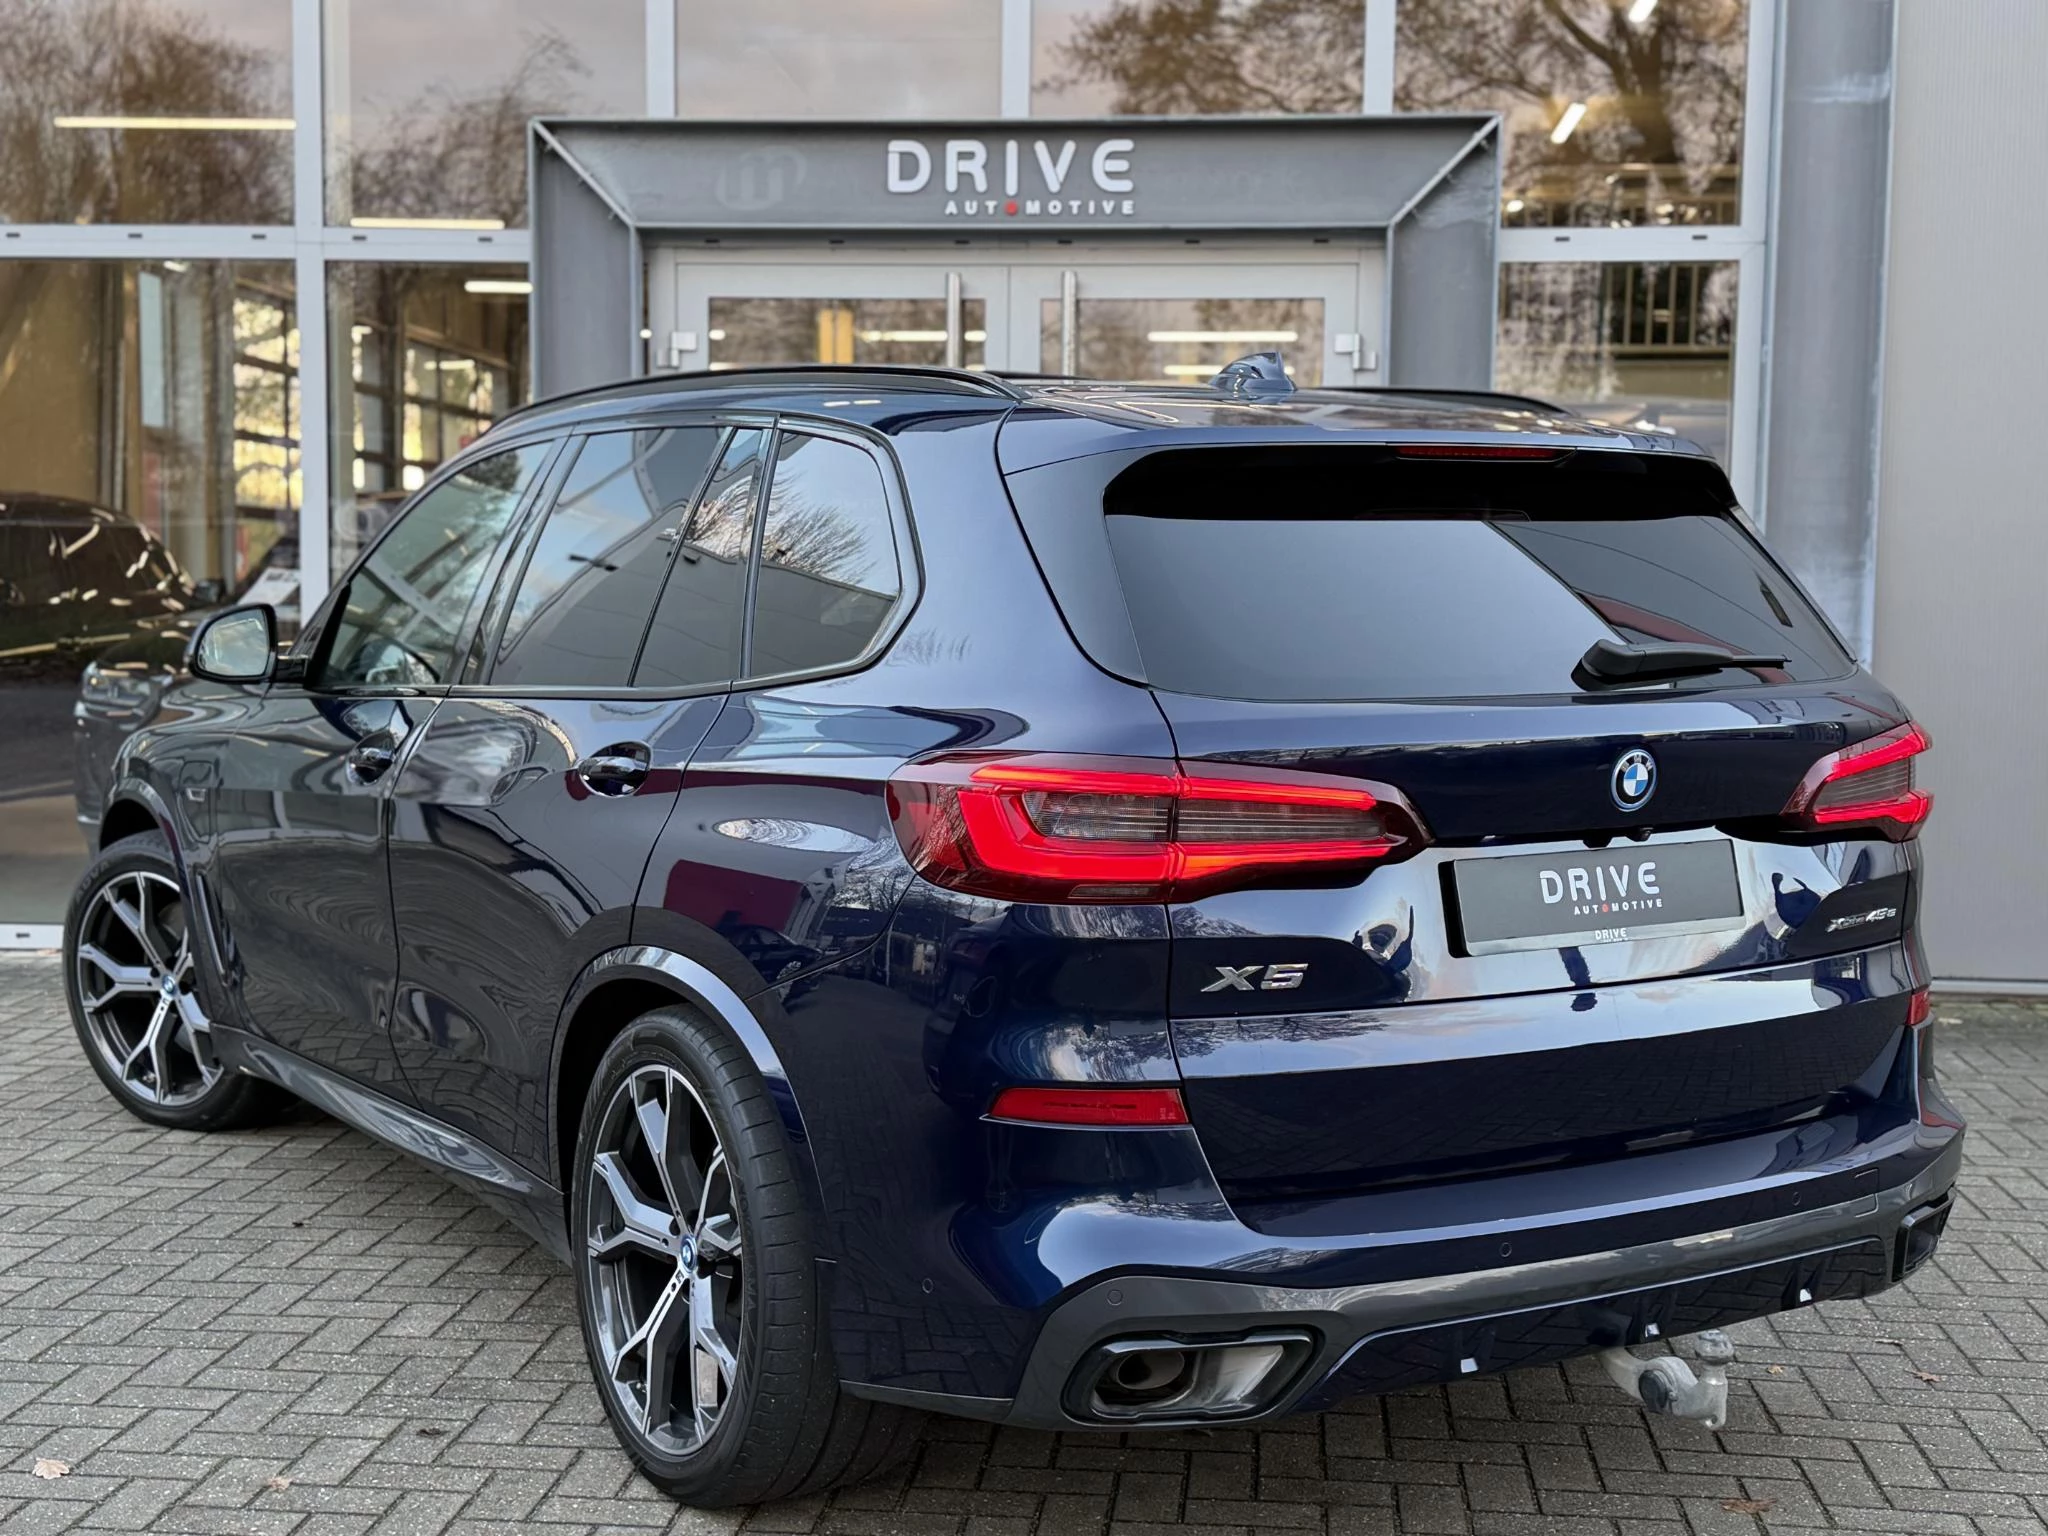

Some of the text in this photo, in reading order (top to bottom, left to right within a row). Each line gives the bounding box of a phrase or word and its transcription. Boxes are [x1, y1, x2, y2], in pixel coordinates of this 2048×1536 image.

[887, 139, 1135, 197] DRIVE
[944, 199, 1135, 216] AUTOMOTIVE
[1539, 862, 1660, 904] DRIVE
[1574, 898, 1663, 916] AUTOMOTIVE
[1595, 927, 1628, 941] DRIVE
[1200, 963, 1309, 992] X5
